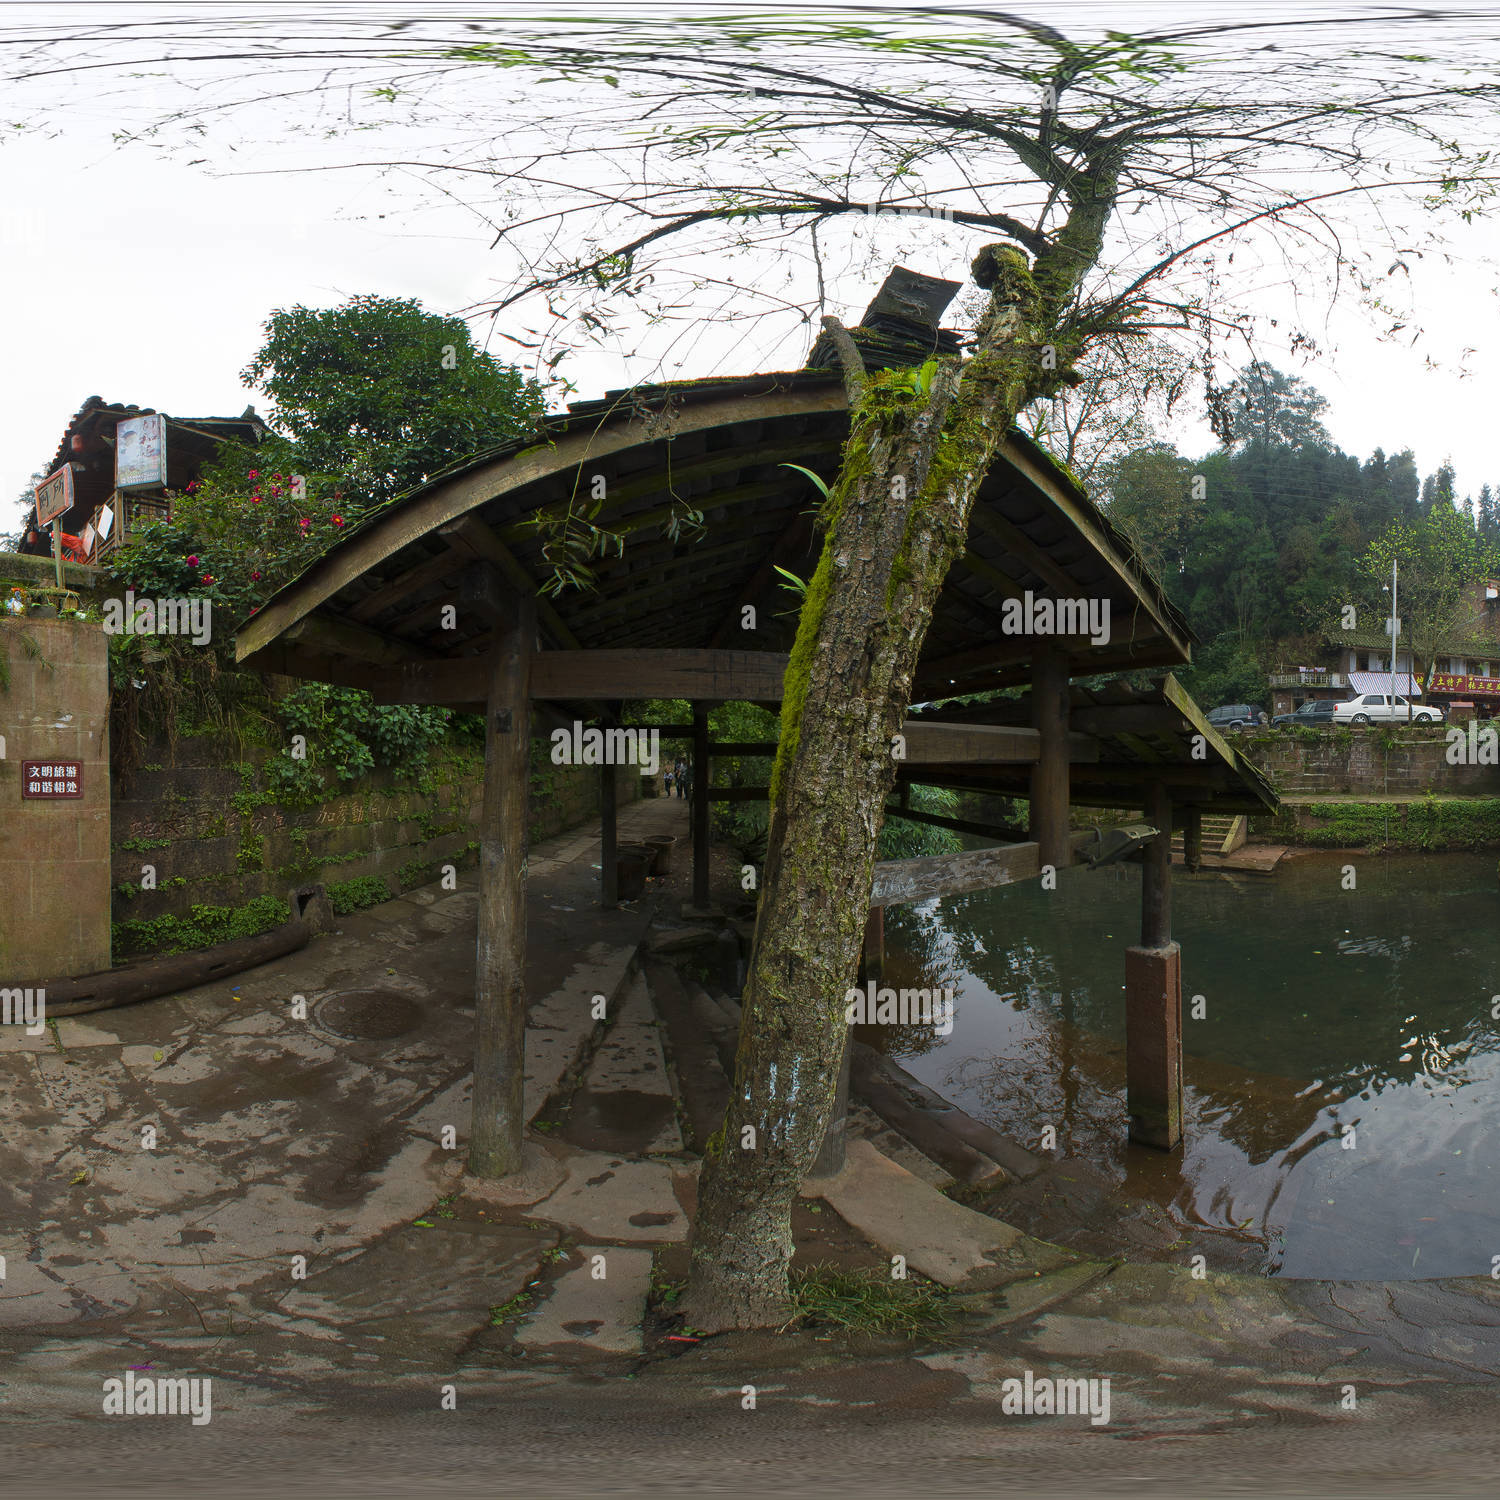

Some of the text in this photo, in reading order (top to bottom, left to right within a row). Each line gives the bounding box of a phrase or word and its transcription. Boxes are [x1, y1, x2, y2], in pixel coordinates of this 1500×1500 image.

[28, 766, 77, 778] 文明旅游
[28, 781, 77, 793] 和谐相处
